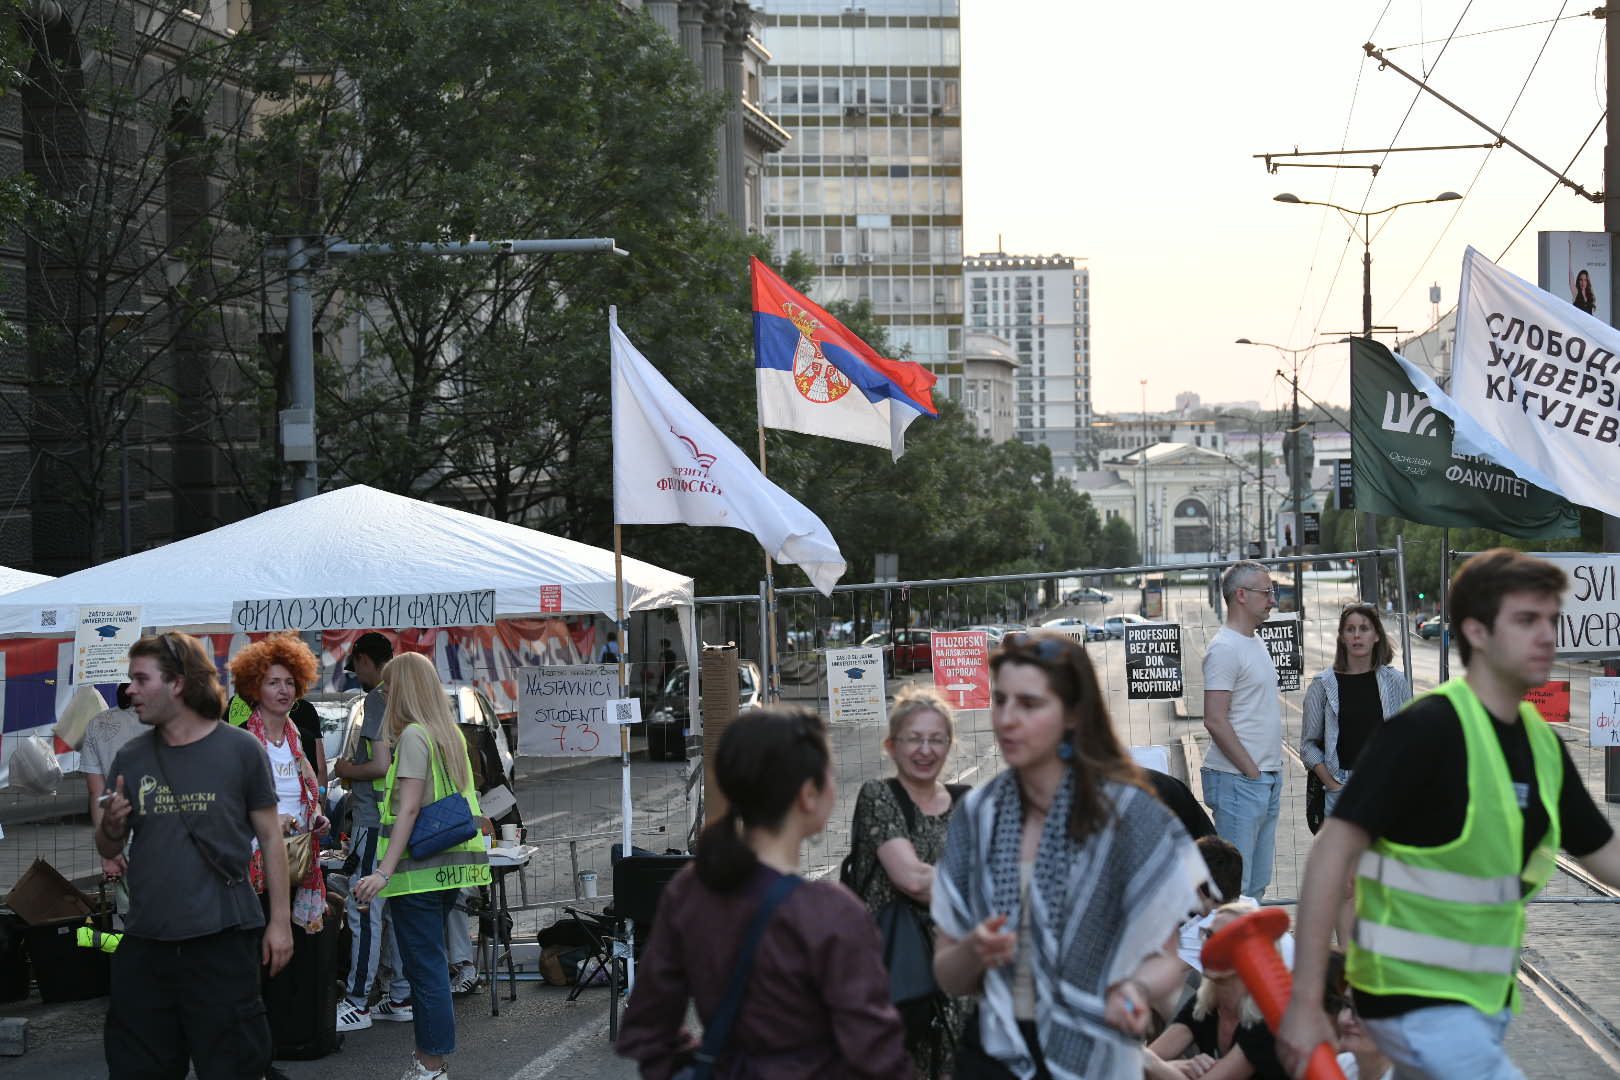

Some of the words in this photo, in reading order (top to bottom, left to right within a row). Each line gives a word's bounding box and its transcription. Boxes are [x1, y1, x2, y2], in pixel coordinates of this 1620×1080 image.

[1445, 465, 1529, 498] ФАКУЛТЕТ
[1573, 565, 1616, 602] SVI
[238, 596, 400, 631] ФИЛОЗОФСКИ
[407, 590, 496, 626] ФАКУЛТЕТ
[1128, 628, 1178, 641] PROFESORI
[1261, 625, 1294, 640] GAZITE
[935, 635, 984, 648] FILOZOFSKI
[1130, 642, 1147, 654] BEZ
[1148, 641, 1179, 654] PLATE,
[1271, 640, 1293, 653] KOJI
[956, 657, 982, 667] PRAVAC
[1145, 655, 1164, 667] DOK
[946, 667, 977, 677] OTPORA!
[1132, 667, 1178, 680] NEZNANJE
[1131, 680, 1181, 693] PROFITIRA!
[551, 723, 600, 752] 7.3
